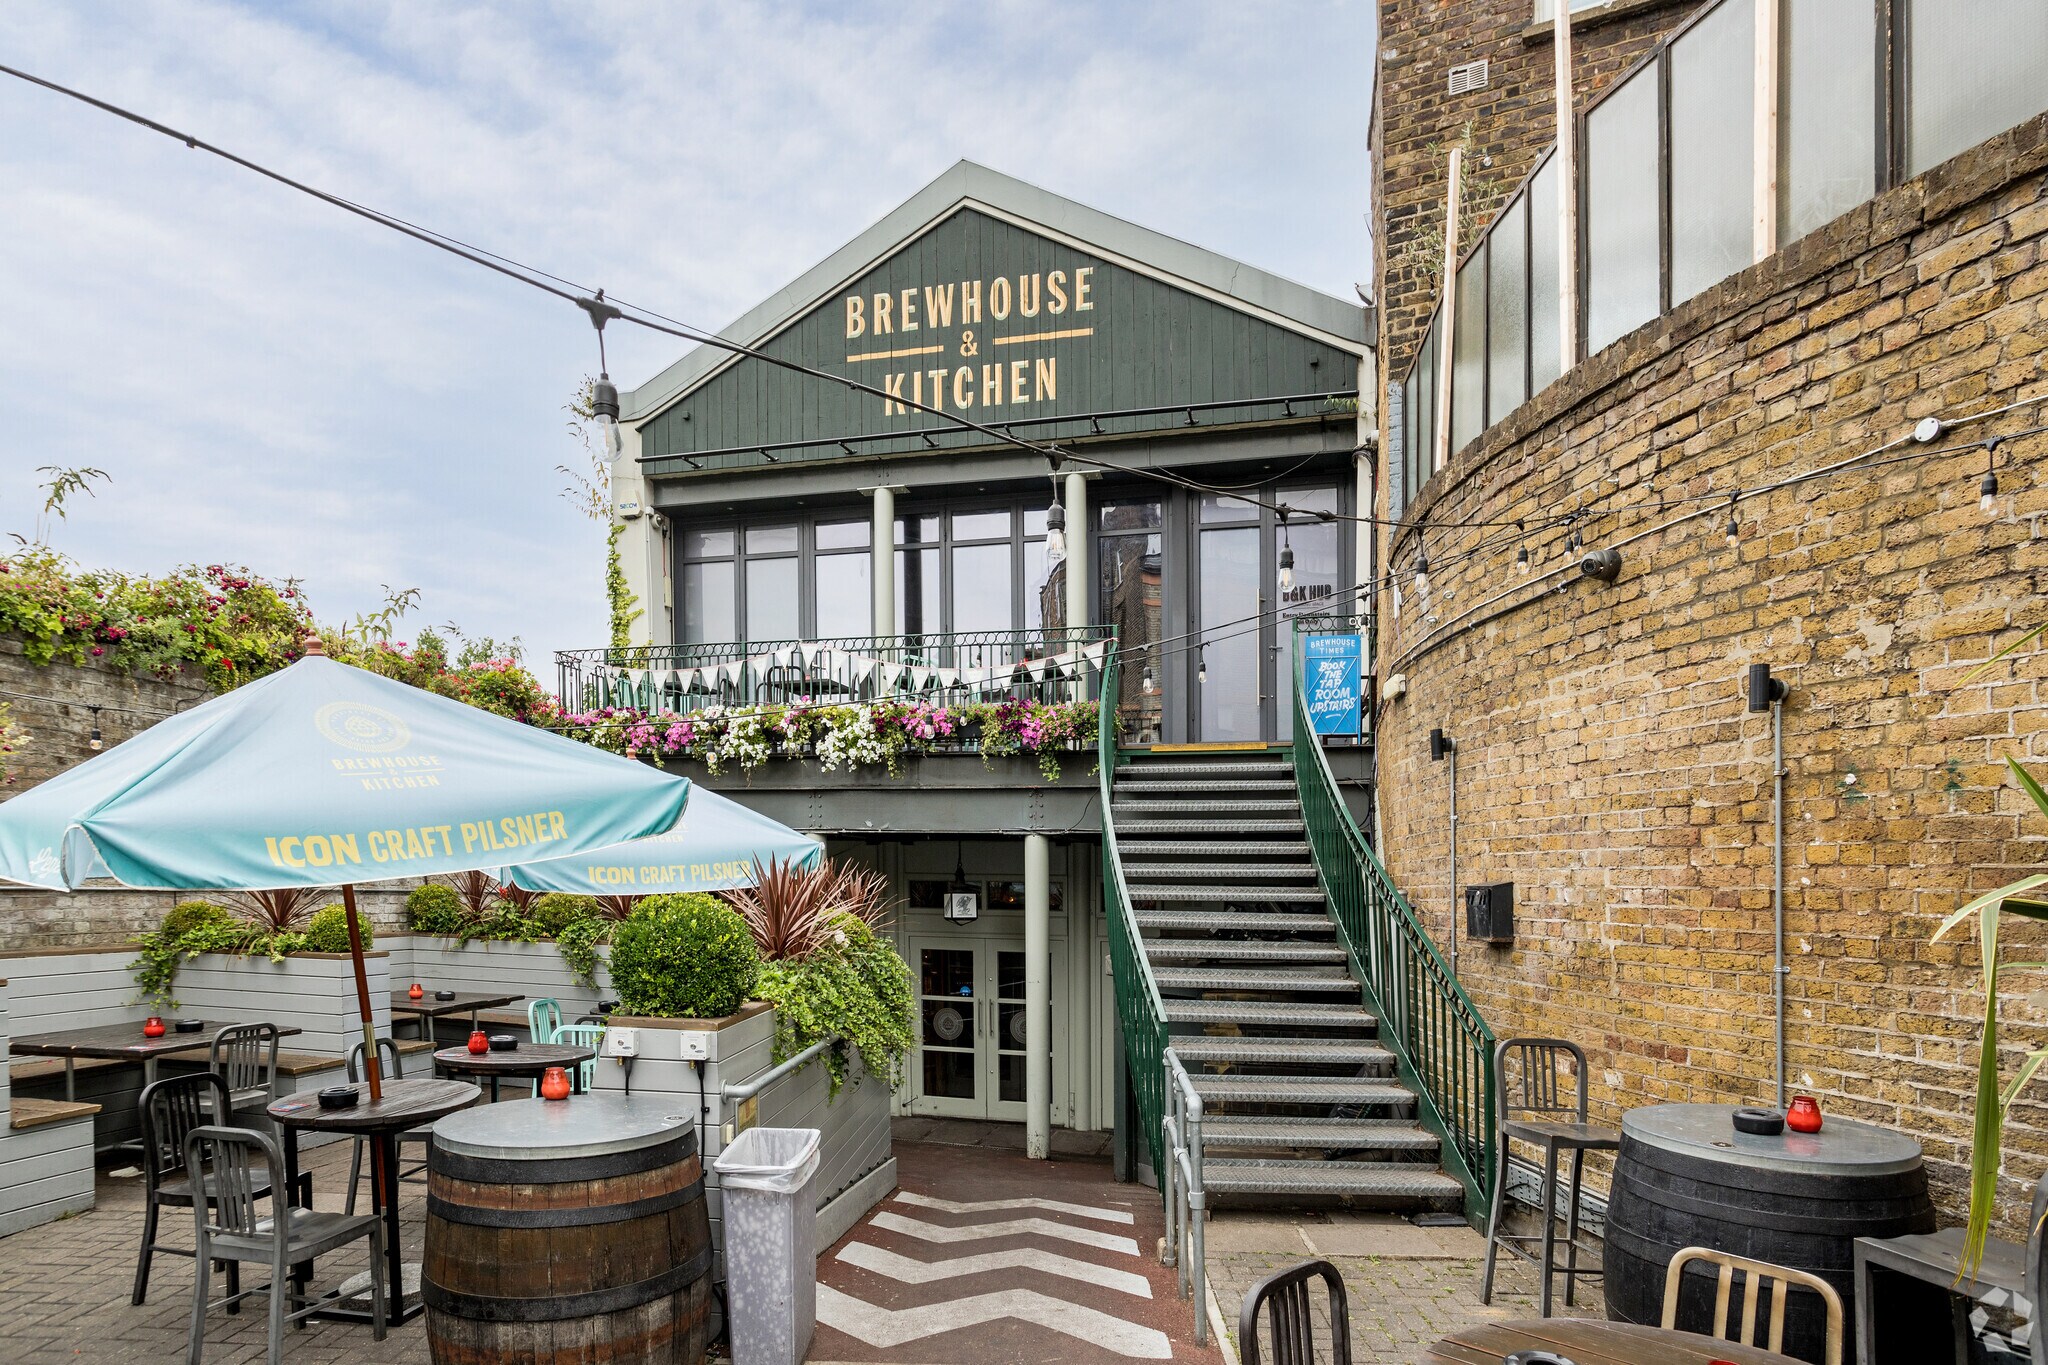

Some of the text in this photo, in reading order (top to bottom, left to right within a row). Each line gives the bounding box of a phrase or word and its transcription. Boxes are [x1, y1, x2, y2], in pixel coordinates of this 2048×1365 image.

[846, 266, 1094, 339] BREWHOUSE
[959, 330, 979, 357] &
[884, 357, 1056, 416] KITCHEN
[1308, 584, 1332, 600] HUB
[1310, 639, 1355, 649] BREWHOUSE
[1319, 660, 1346, 672] BOOK
[1324, 670, 1343, 680] THE
[1319, 678, 1343, 689] TAP
[1315, 687, 1351, 701] ROOM
[1309, 697, 1356, 714] UPSTAIRS
[331, 755, 442, 770] BREWHOUSE
[361, 774, 441, 791] KITCHEN
[264, 810, 569, 868] ICON CRAFT PILSNER
[588, 860, 751, 885] ICON CRAFT PILSNER
